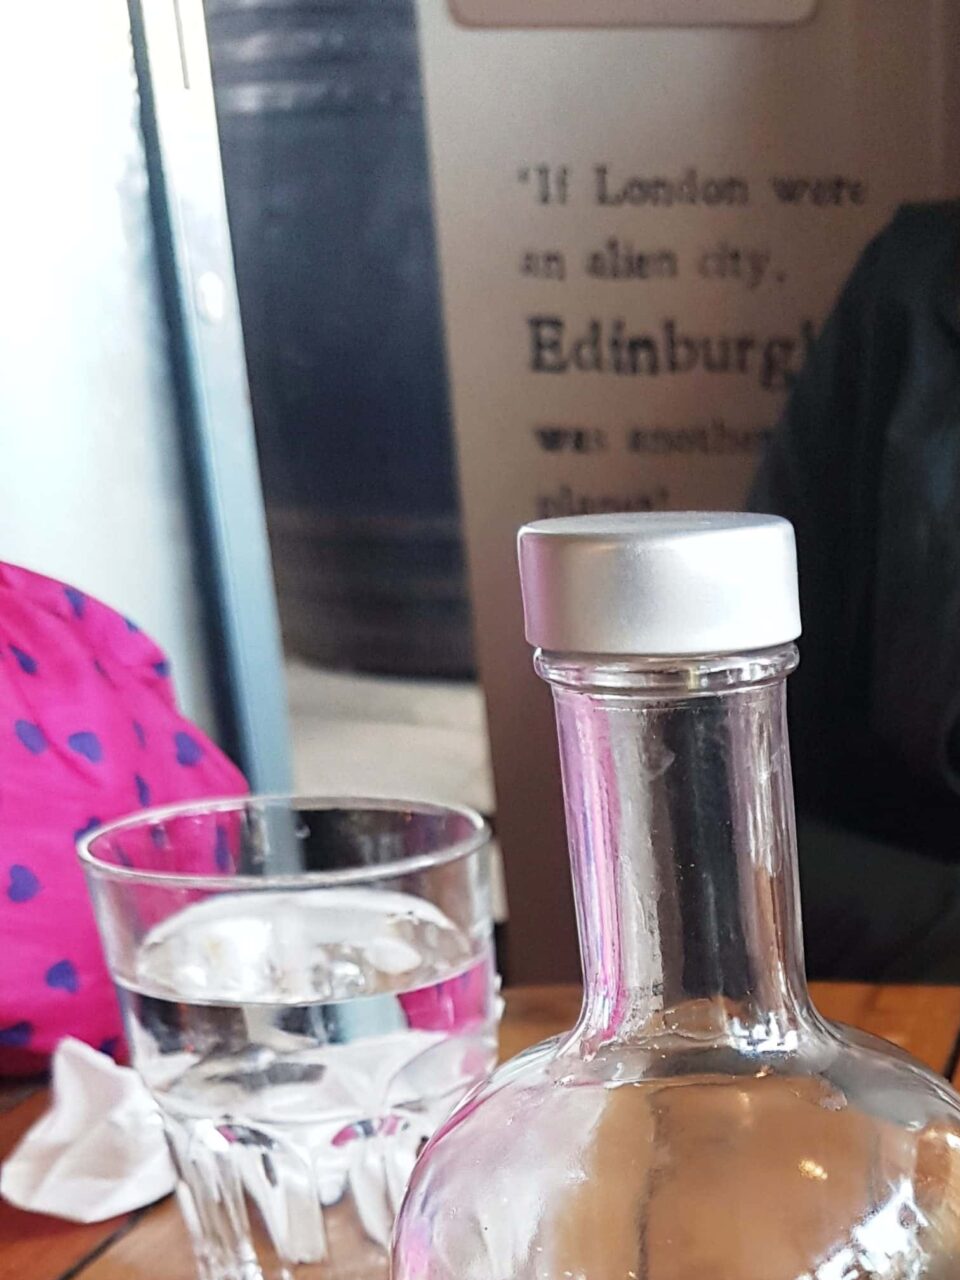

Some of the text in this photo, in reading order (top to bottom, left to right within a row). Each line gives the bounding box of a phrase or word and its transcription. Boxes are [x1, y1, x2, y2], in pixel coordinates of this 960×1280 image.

[594, 162, 750, 206] London
[770, 174, 868, 206] were
[520, 249, 567, 281] an
[586, 236, 679, 280] alien
[535, 427, 608, 453] was
